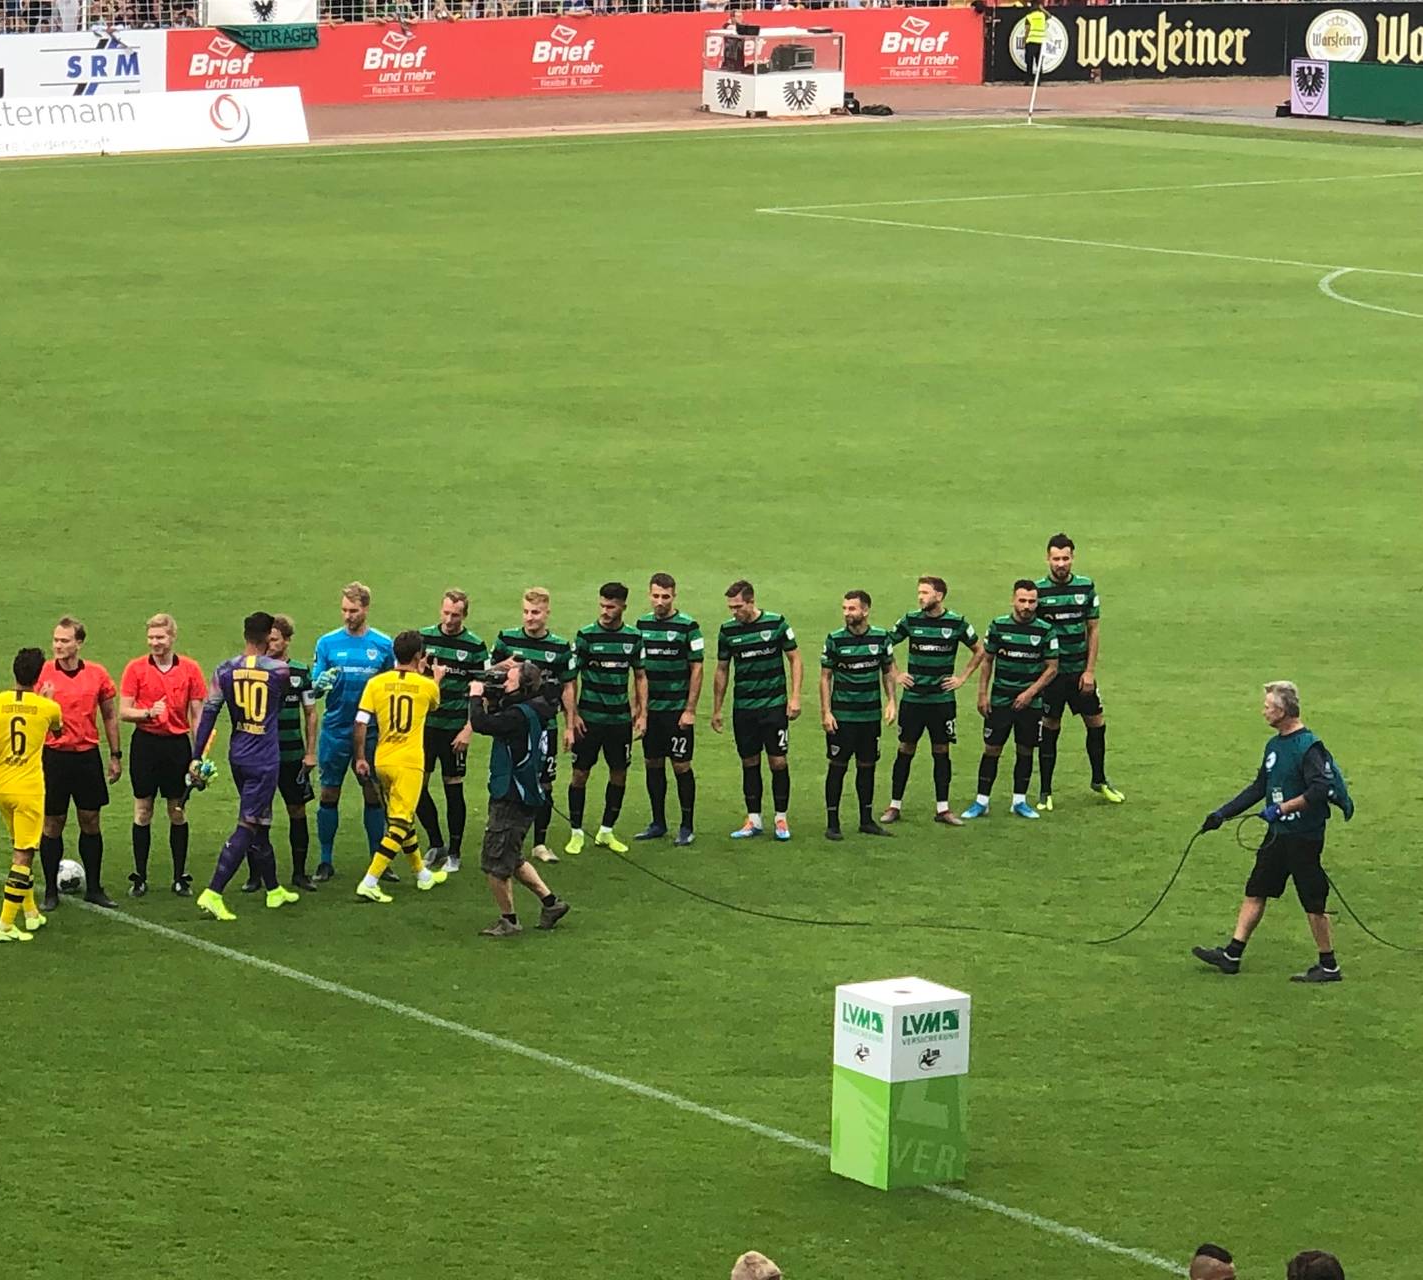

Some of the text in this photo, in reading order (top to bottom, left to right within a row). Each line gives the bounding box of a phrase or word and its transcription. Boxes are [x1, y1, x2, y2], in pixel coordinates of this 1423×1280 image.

[532, 39, 596, 63] Brief
[881, 31, 949, 53] Brief
[1075, 10, 1251, 73] Warsteiner
[188, 52, 255, 76] Brief
[363, 46, 428, 70] Brief
[547, 62, 604, 76] und mehr
[897, 54, 958, 65] und mehr
[205, 76, 264, 89] und mehr
[379, 69, 436, 82] und mehr
[233, 680, 269, 722] 40
[389, 694, 413, 734] 10
[10, 716, 27, 756] 6
[671, 736, 687, 754] 22
[842, 1002, 871, 1031] LVM
[902, 1012, 941, 1037] LVM
